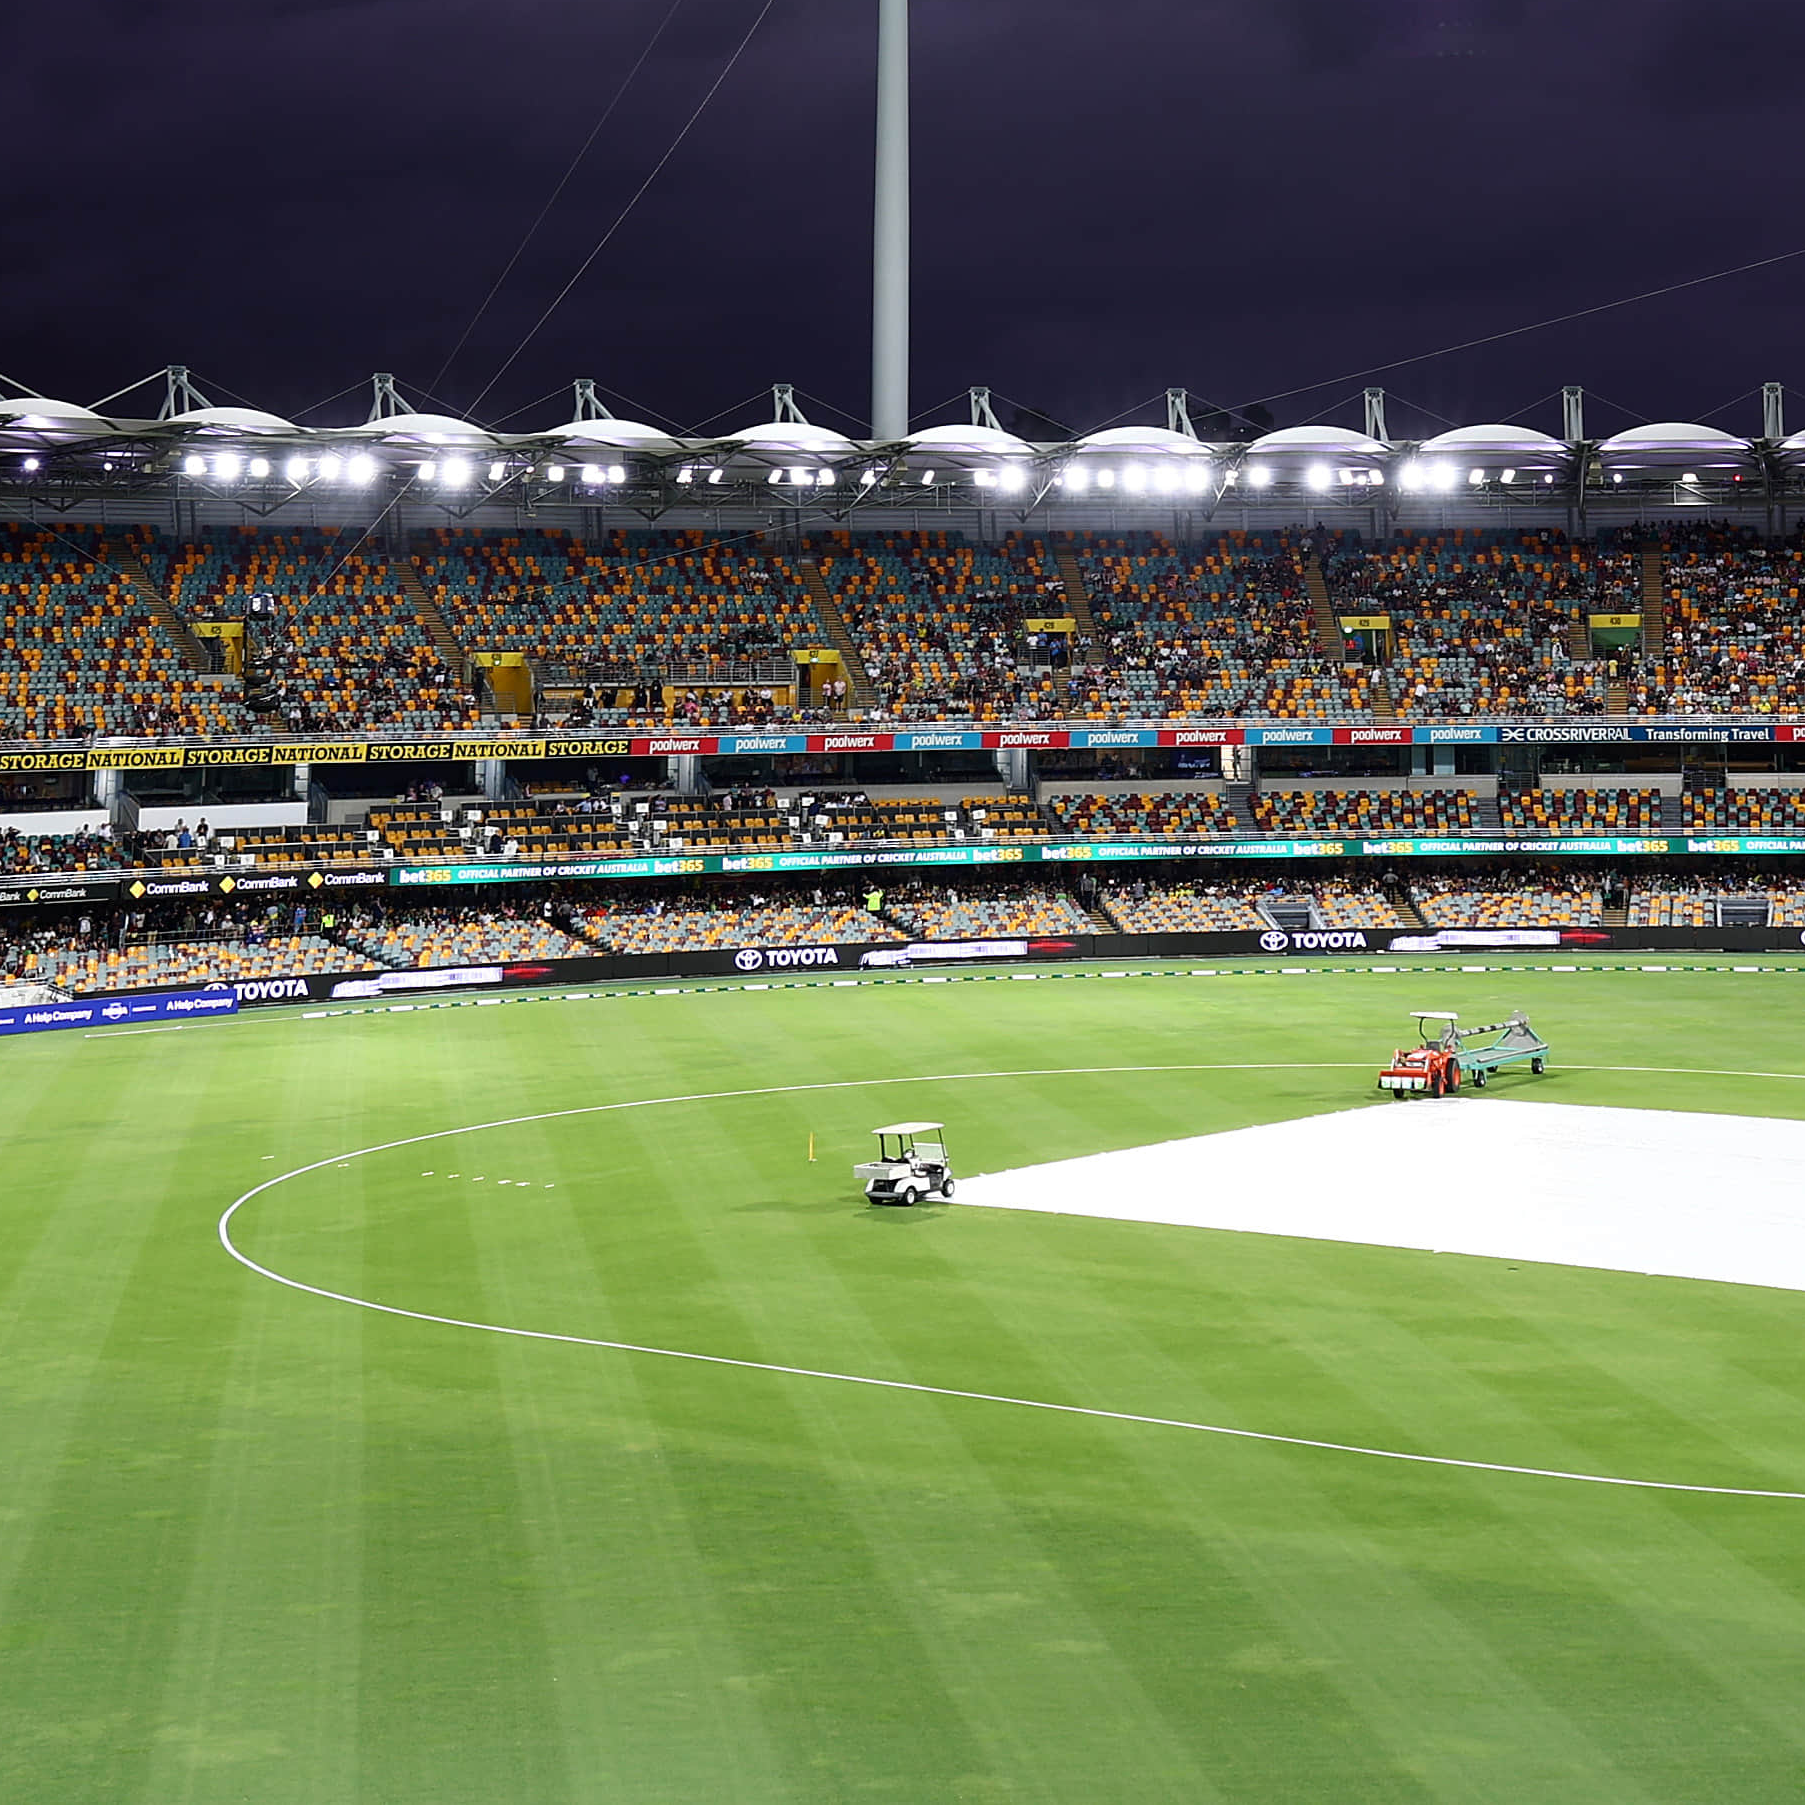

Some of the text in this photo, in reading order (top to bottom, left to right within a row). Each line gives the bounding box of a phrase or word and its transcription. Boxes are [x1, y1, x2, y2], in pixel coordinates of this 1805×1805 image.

[912, 733, 962, 749] poolwerx
[1000, 732, 1049, 747] poolwerx
[1088, 731, 1139, 745] poolwerx
[1176, 730, 1226, 745] poolwerx
[1263, 729, 1313, 744] poolwerx
[1351, 727, 1401, 742] poolwerx
[1430, 727, 1481, 742] poolwerx
[1646, 727, 1729, 743] Transforming
[1731, 727, 1769, 741] Travel
[453, 740, 628, 759] NATIONAL STORAGE
[650, 738, 699, 753] poolwerx
[736, 737, 786, 752] poolwerx
[824, 735, 875, 751] poolwerx
[88, 748, 270, 769] NATIONAL STORAGE
[274, 744, 450, 762] NATIONAL STORAGE
[0, 753, 84, 770] STORAGE
[1042, 846, 1092, 860] bet365
[1099, 847, 1139, 858] OFFICIAL
[1142, 846, 1180, 857] PARTNER
[1197, 846, 1234, 856] CRICKET
[1235, 845, 1287, 855] AUSTRALIA
[1294, 842, 1344, 856] bet365
[458, 868, 498, 880] OFFICIAL
[500, 867, 541, 879] PARTNER
[558, 865, 595, 877] CRICKET
[597, 862, 648, 875] AUSTRALIA
[654, 859, 704, 874] bet365
[237, 875, 297, 891] CommBank
[325, 871, 384, 887] CommBank
[399, 868, 451, 884] bet365
[39, 888, 86, 900] CommBank
[146, 880, 209, 896] CommBank
[1292, 931, 1367, 949] TOYOTA
[765, 948, 838, 966] TOYOTA
[236, 979, 309, 1000] TOYOTA
